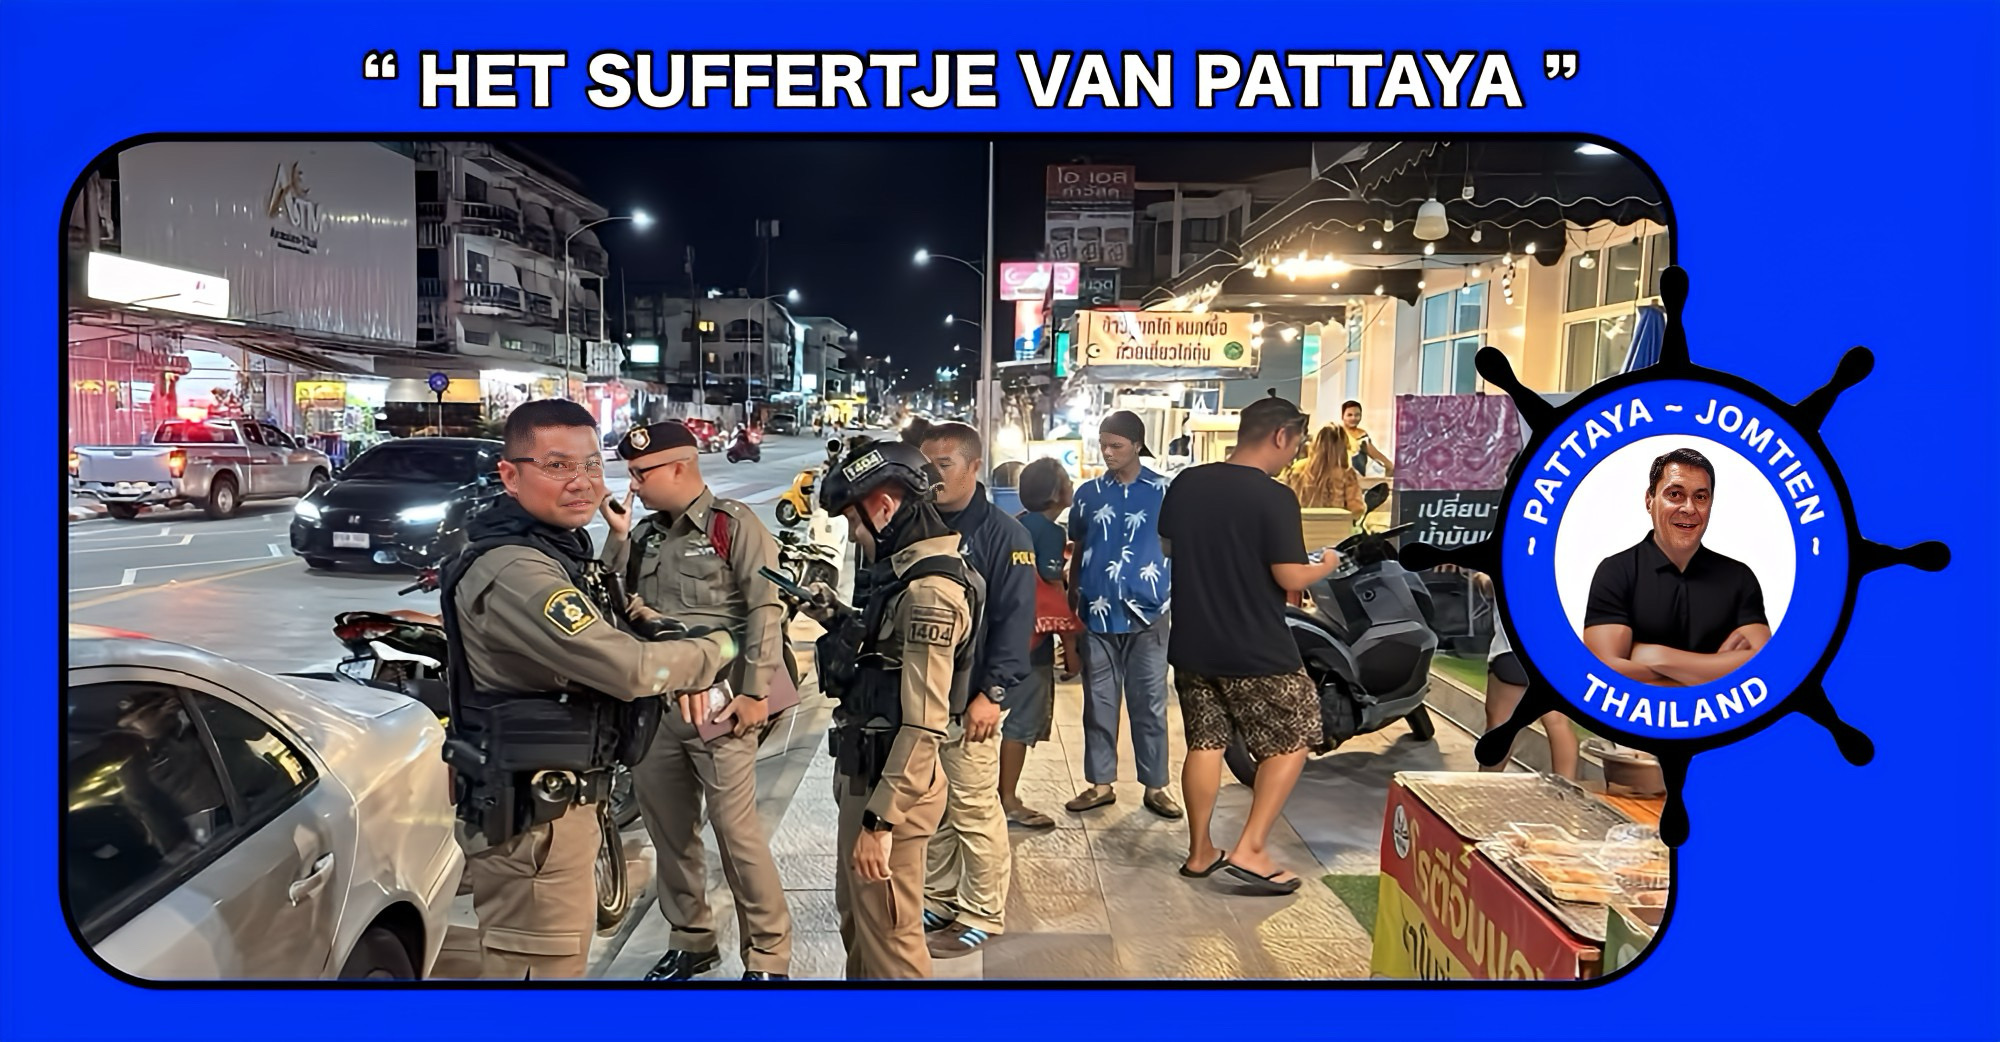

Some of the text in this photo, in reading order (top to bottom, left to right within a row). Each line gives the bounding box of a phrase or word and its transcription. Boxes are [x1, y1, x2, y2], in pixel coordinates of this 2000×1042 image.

[1102, 315, 1171, 335] ข้าวมกไก่
[847, 453, 879, 477] 1404
[1418, 492, 1499, 518] เปลี่ยน
[911, 622, 952, 641] 1404
